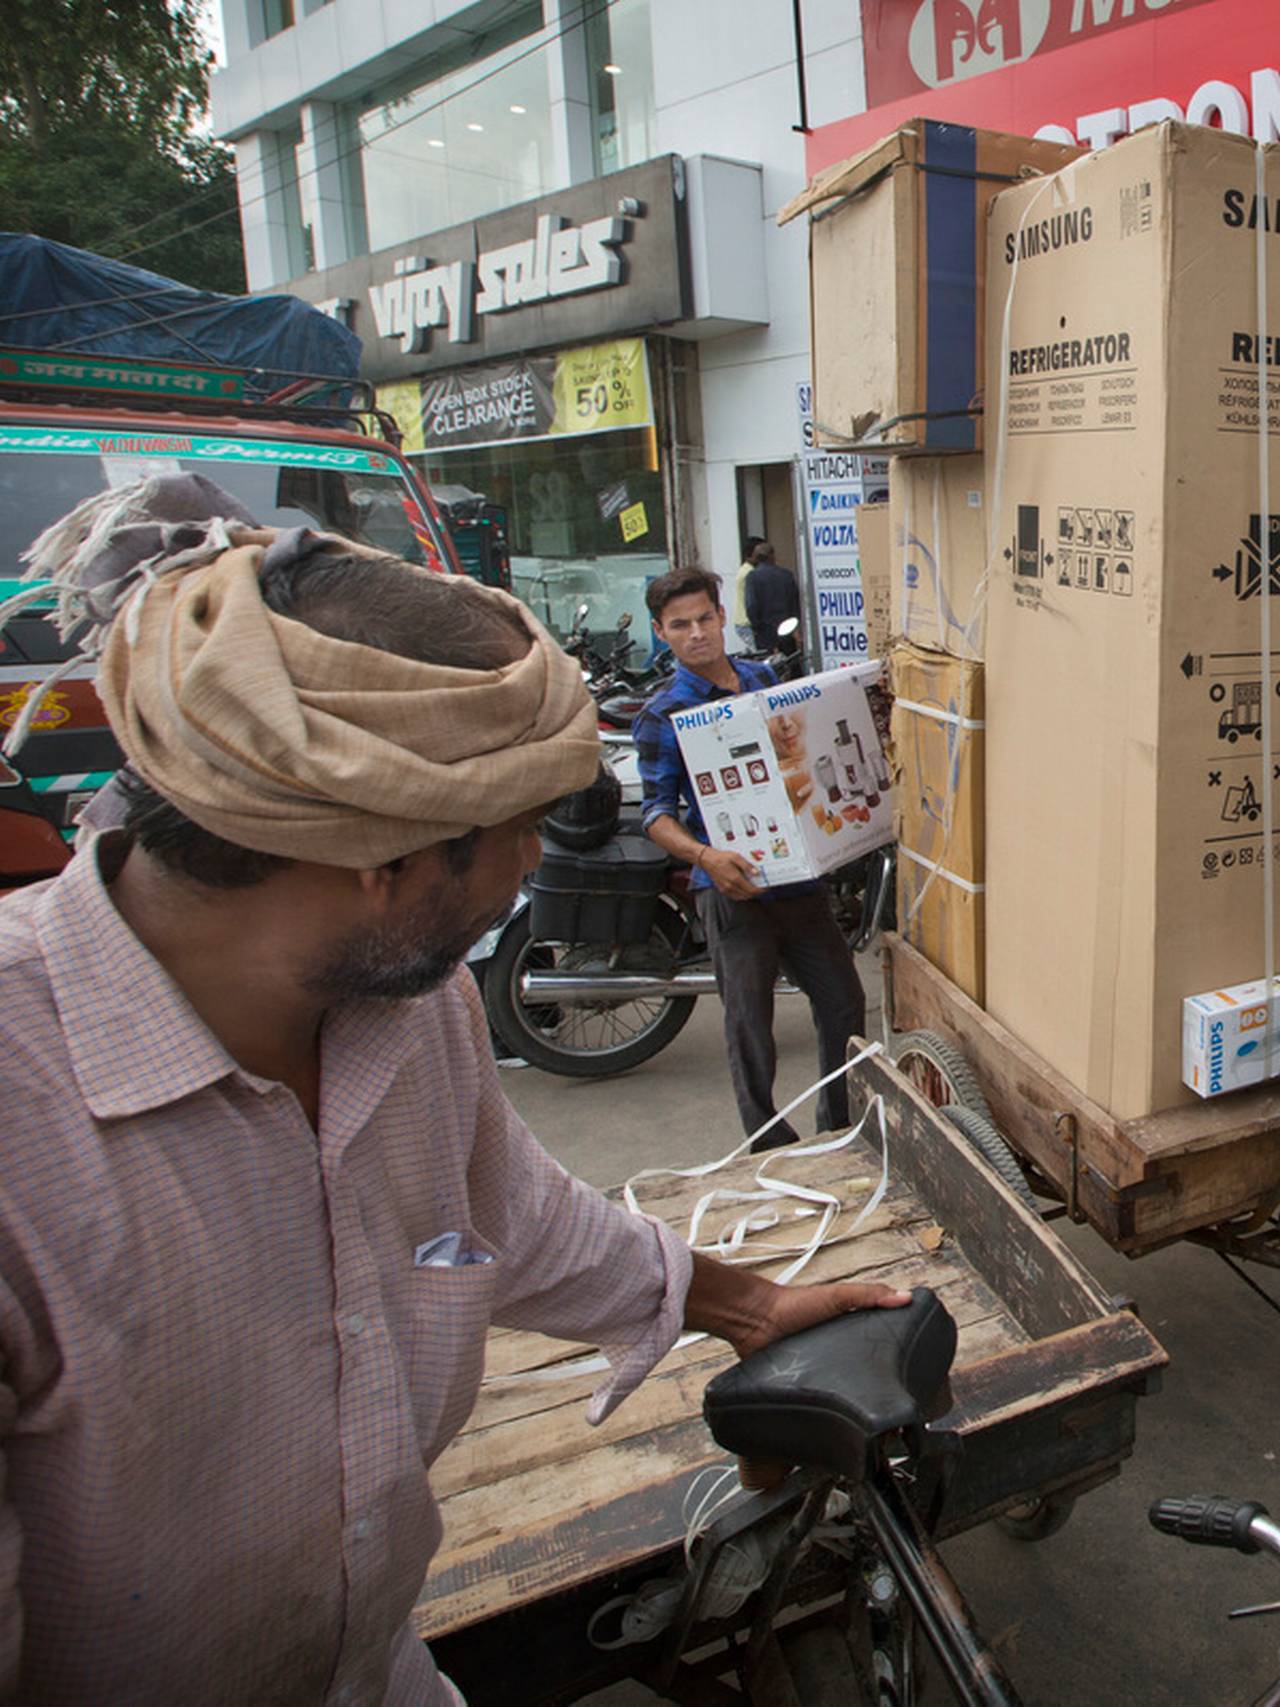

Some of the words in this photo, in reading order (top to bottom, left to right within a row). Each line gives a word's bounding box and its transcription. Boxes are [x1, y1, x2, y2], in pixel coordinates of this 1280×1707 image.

[1005, 206, 1093, 265] SAMSUNG
[1009, 332, 1131, 376] REFRIGERATOR
[431, 393, 464, 414] OPEN
[465, 387, 489, 407] BOX
[490, 372, 533, 396] STOCK
[576, 385, 609, 418] 50
[432, 391, 536, 436] CLEARANCE
[0, 430, 95, 450] ndia
[807, 456, 860, 481] HITACHI
[820, 493, 861, 511] DAIKIN
[813, 525, 857, 547] VOLTA
[819, 591, 864, 617] PHILIP
[822, 625, 869, 651] Haie
[767, 683, 822, 711] PHILIPS
[675, 703, 734, 732] PHILIPS
[1209, 1020, 1224, 1094] PHILIPS
